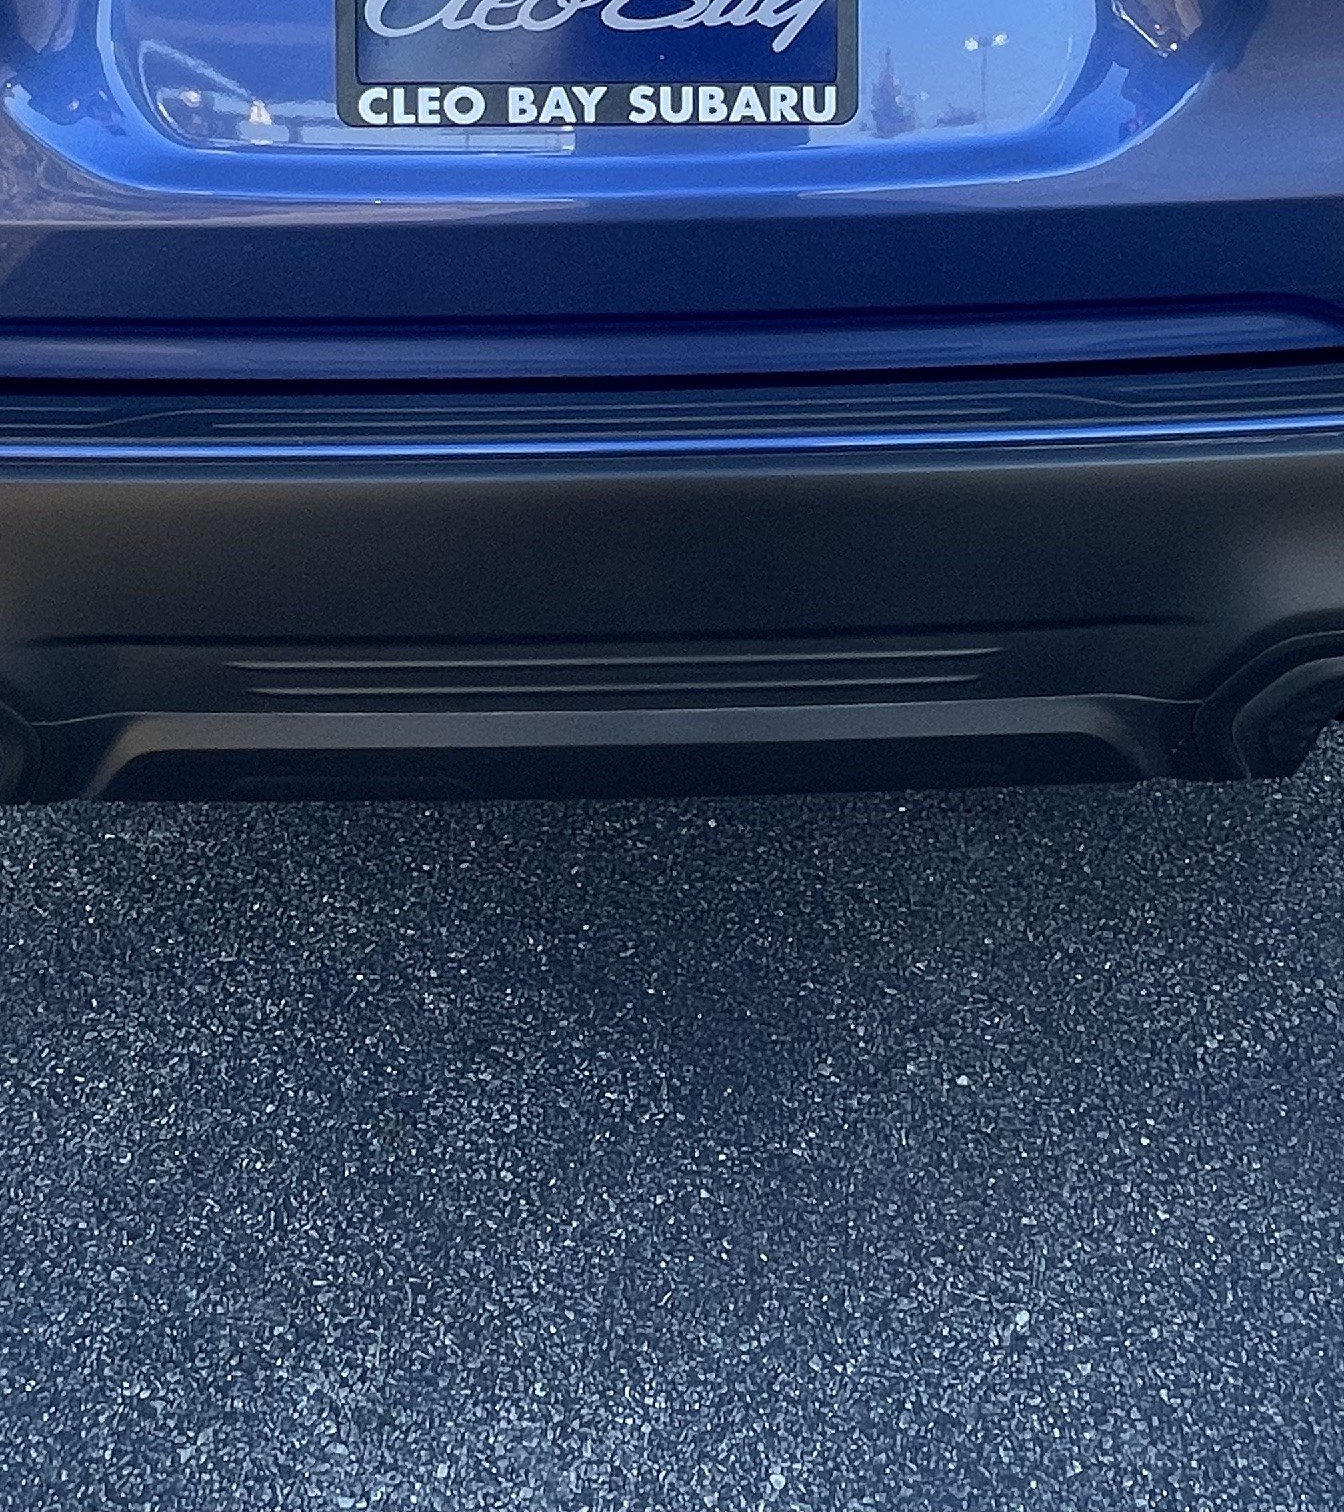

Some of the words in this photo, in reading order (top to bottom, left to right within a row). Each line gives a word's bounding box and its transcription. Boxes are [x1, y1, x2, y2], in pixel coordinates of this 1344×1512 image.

[358, 87, 486, 125] CLEO
[507, 87, 608, 124] BAY
[628, 86, 837, 124] SUBARU
